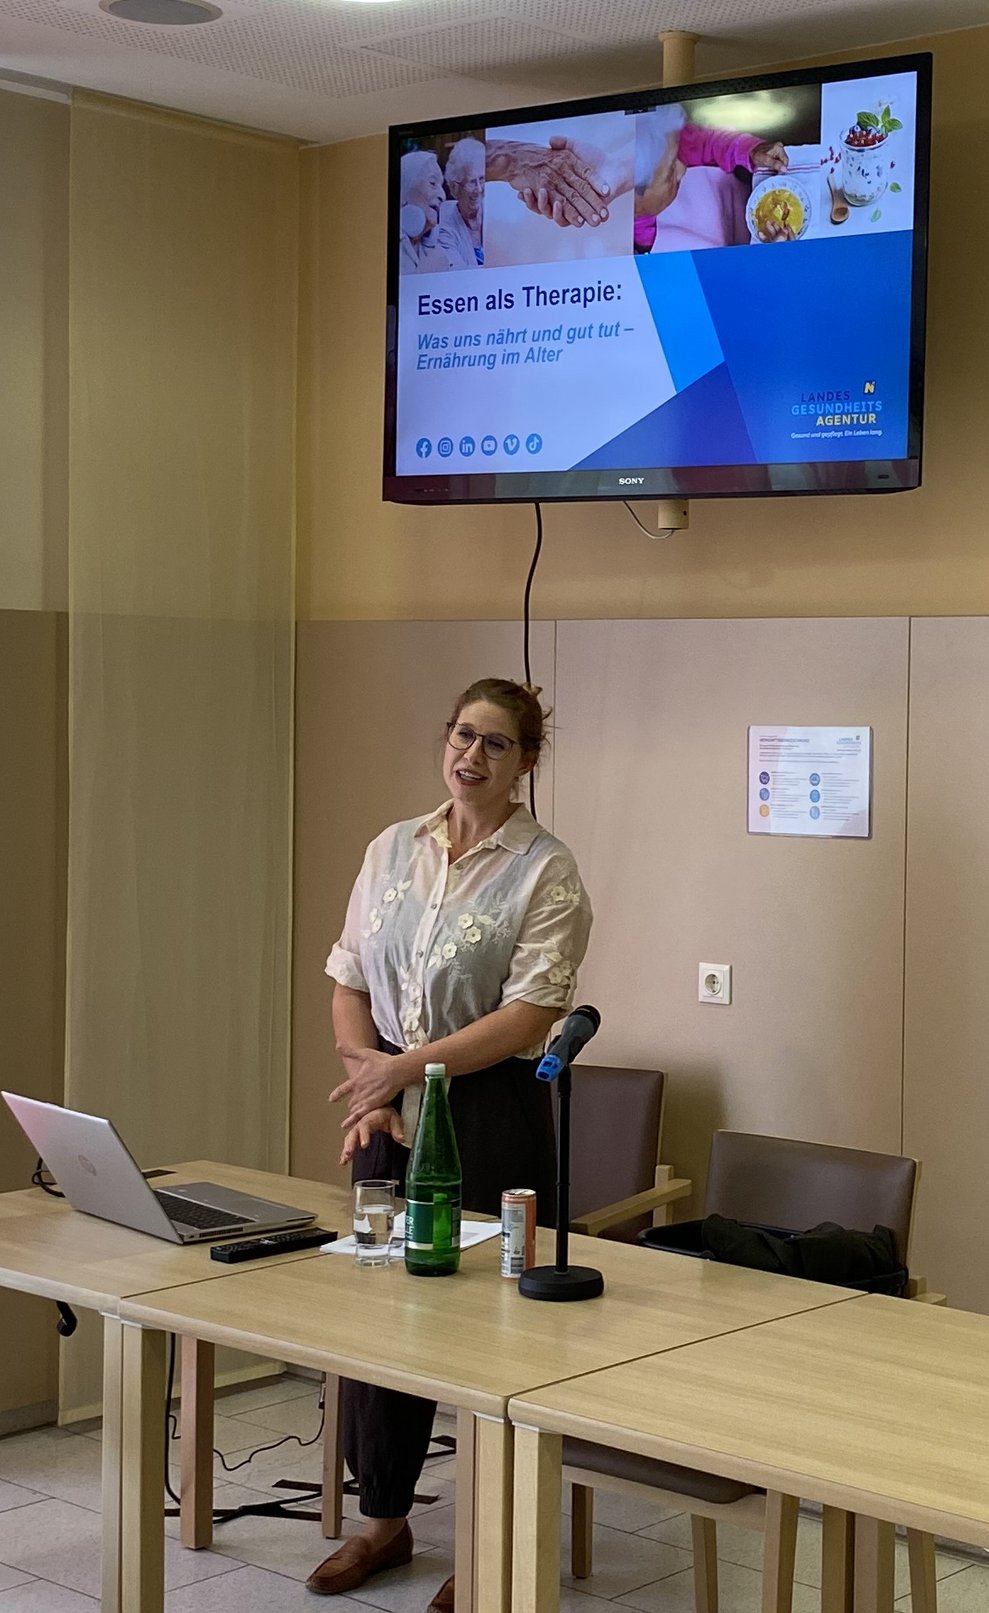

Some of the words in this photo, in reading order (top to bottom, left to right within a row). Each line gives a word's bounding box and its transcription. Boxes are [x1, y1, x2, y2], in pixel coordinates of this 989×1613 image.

[418, 294, 479, 316] Essen
[485, 288, 515, 311] als
[521, 280, 622, 309] Therapie:
[417, 333, 449, 350] Was
[453, 334, 482, 348] uns
[486, 328, 528, 346] nährt
[531, 324, 563, 343] und
[566, 323, 594, 345] gut
[598, 321, 621, 338] tut
[416, 352, 497, 370] Ernährung
[501, 348, 520, 365] im
[523, 346, 564, 364] Alter
[800, 390, 850, 403] LANDES
[791, 400, 883, 416] GESUNDHEITS
[816, 413, 877, 426] AGENTUR
[618, 477, 645, 485] SONY
